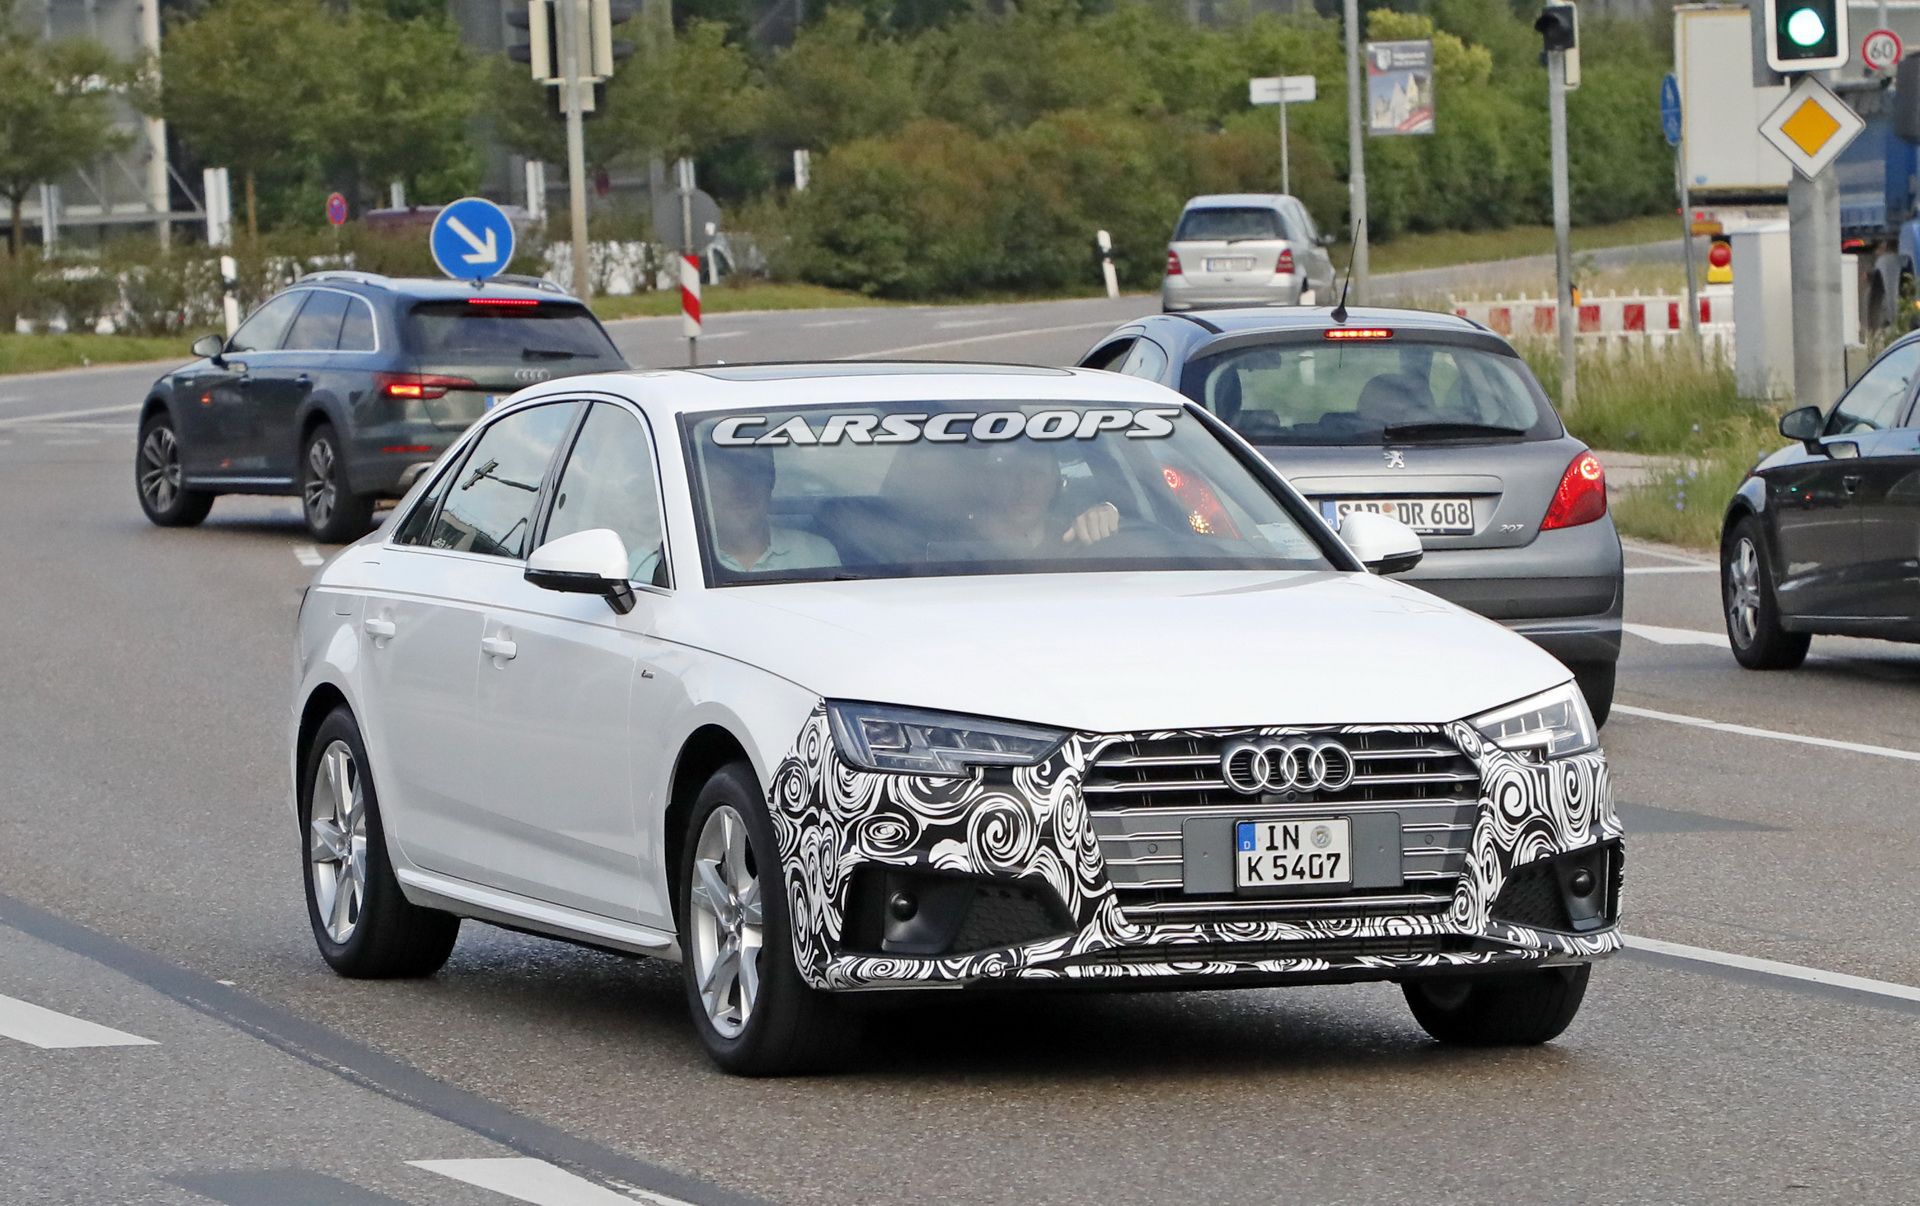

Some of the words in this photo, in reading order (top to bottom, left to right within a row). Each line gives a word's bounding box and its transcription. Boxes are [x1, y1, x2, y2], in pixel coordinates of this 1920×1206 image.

[1871, 40, 1893, 59] 60
[1396, 503, 1425, 525] DR
[1431, 503, 1470, 525] 608
[1499, 524, 1524, 533] 207
[1243, 840, 1251, 850] D
[1266, 825, 1299, 851] IN
[1248, 856, 1264, 881] K
[1273, 853, 1341, 881] 5407
